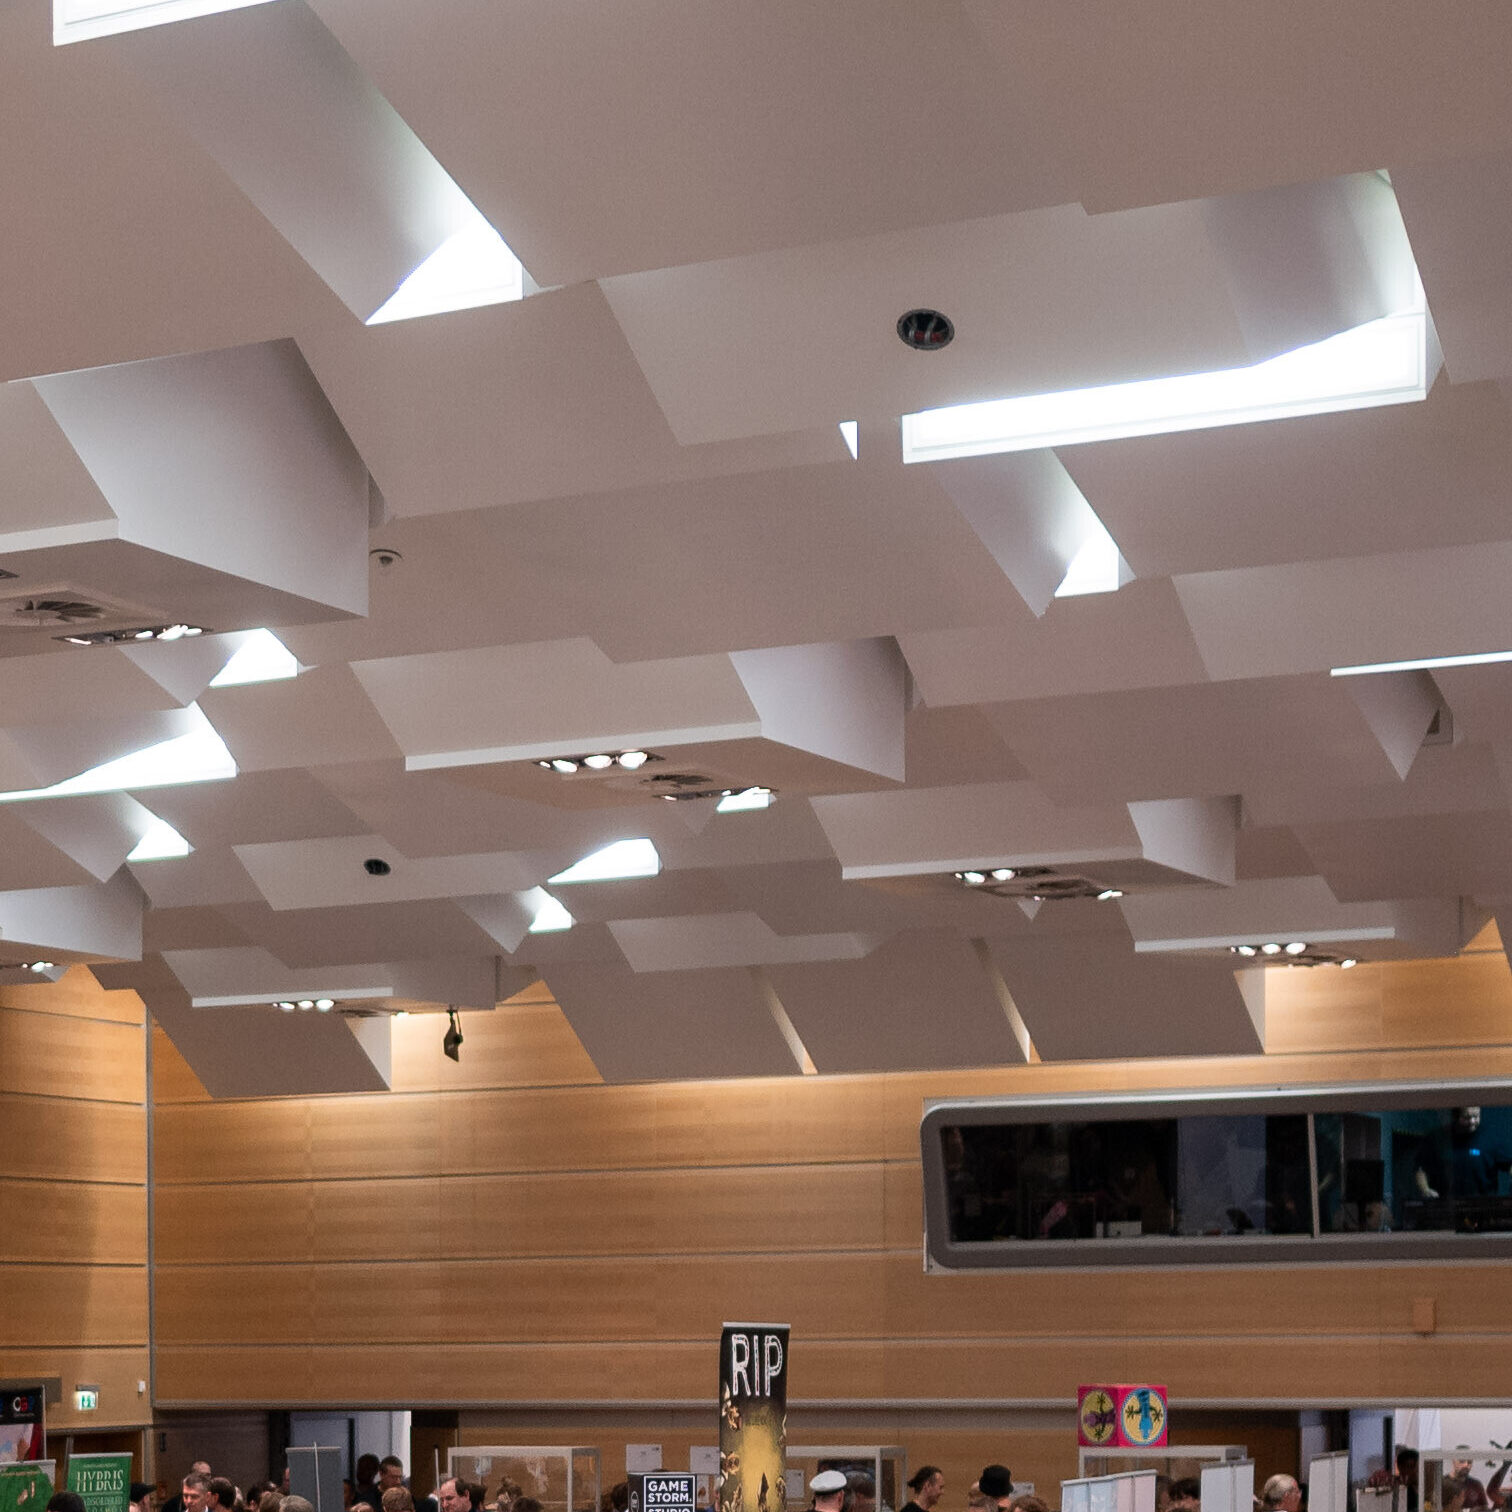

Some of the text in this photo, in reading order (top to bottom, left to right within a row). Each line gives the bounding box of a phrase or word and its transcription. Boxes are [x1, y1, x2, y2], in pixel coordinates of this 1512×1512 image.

[731, 1333, 784, 1398] RIP
[76, 1468, 125, 1492] HYBRIS
[647, 1480, 689, 1493] GAME
